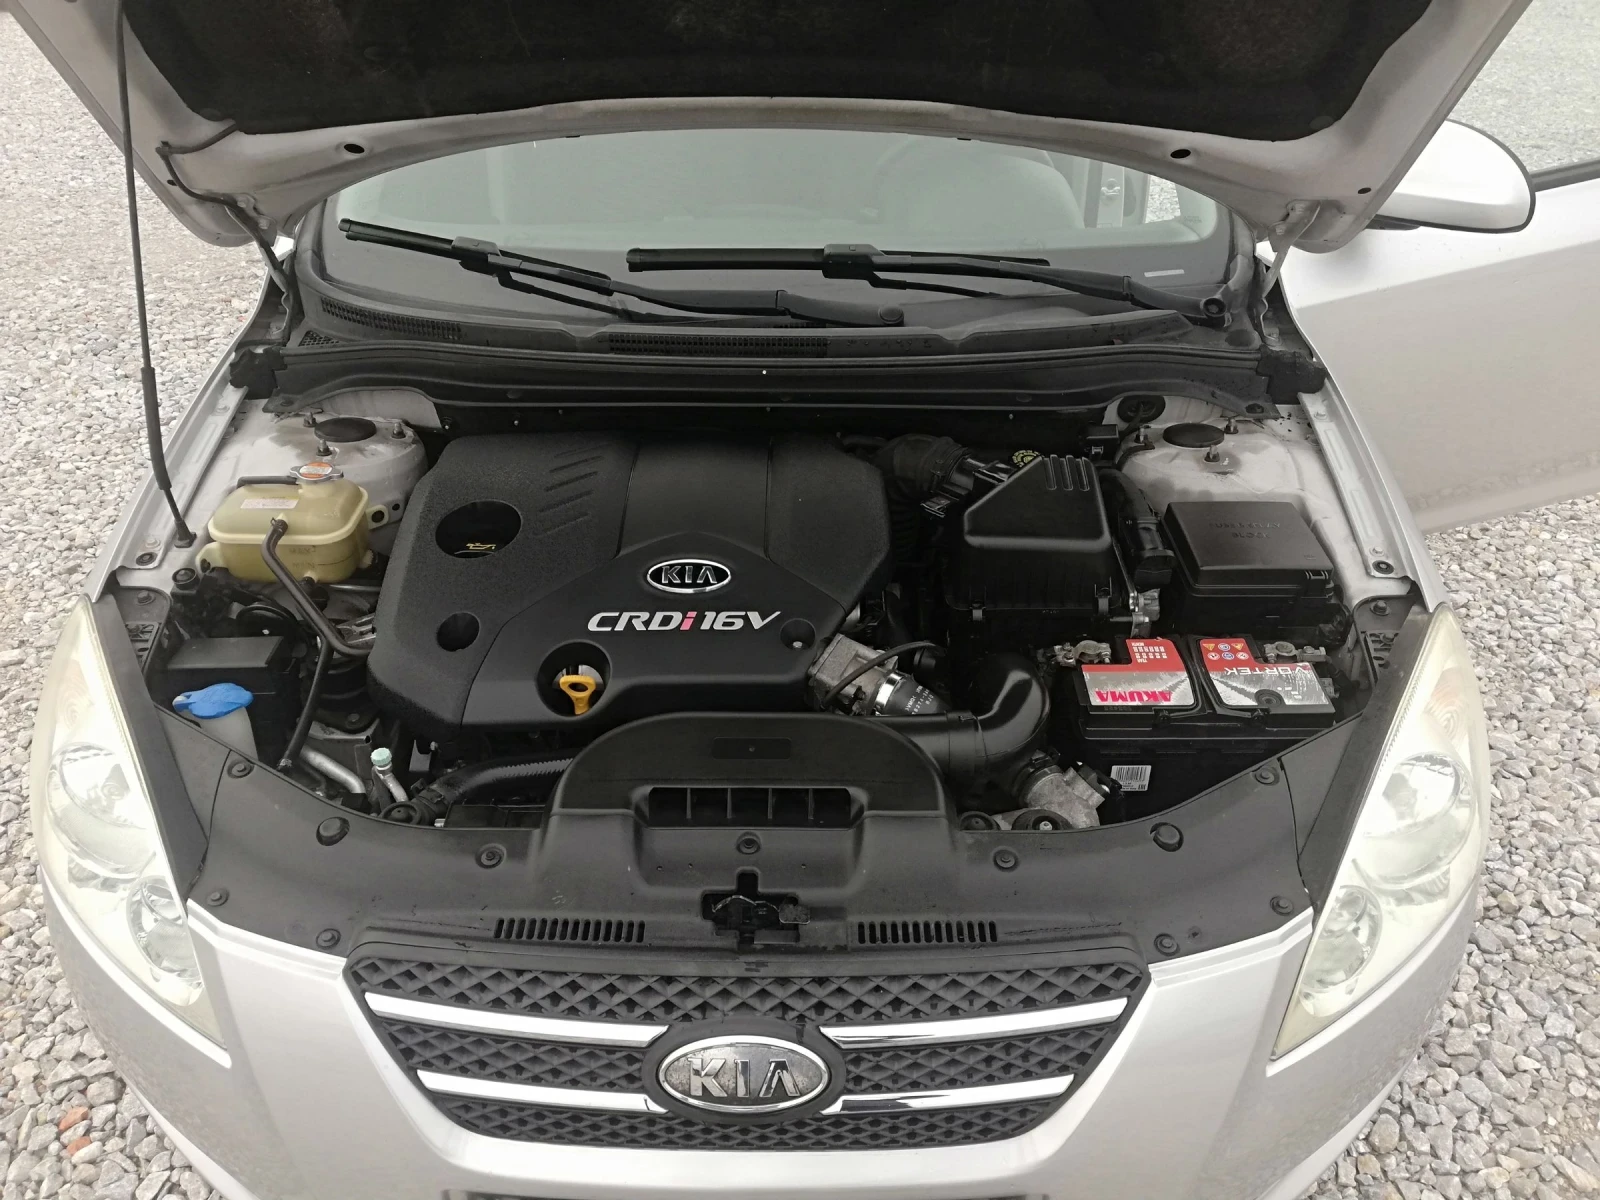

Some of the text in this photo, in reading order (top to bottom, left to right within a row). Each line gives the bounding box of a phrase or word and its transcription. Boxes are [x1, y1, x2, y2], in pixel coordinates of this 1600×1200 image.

[661, 565, 718, 584] KIA
[587, 611, 781, 632] CRDi 16V
[1225, 666, 1311, 676] VORTEK
[1095, 690, 1173, 703] AKUMA
[687, 1057, 801, 1098] KIA
